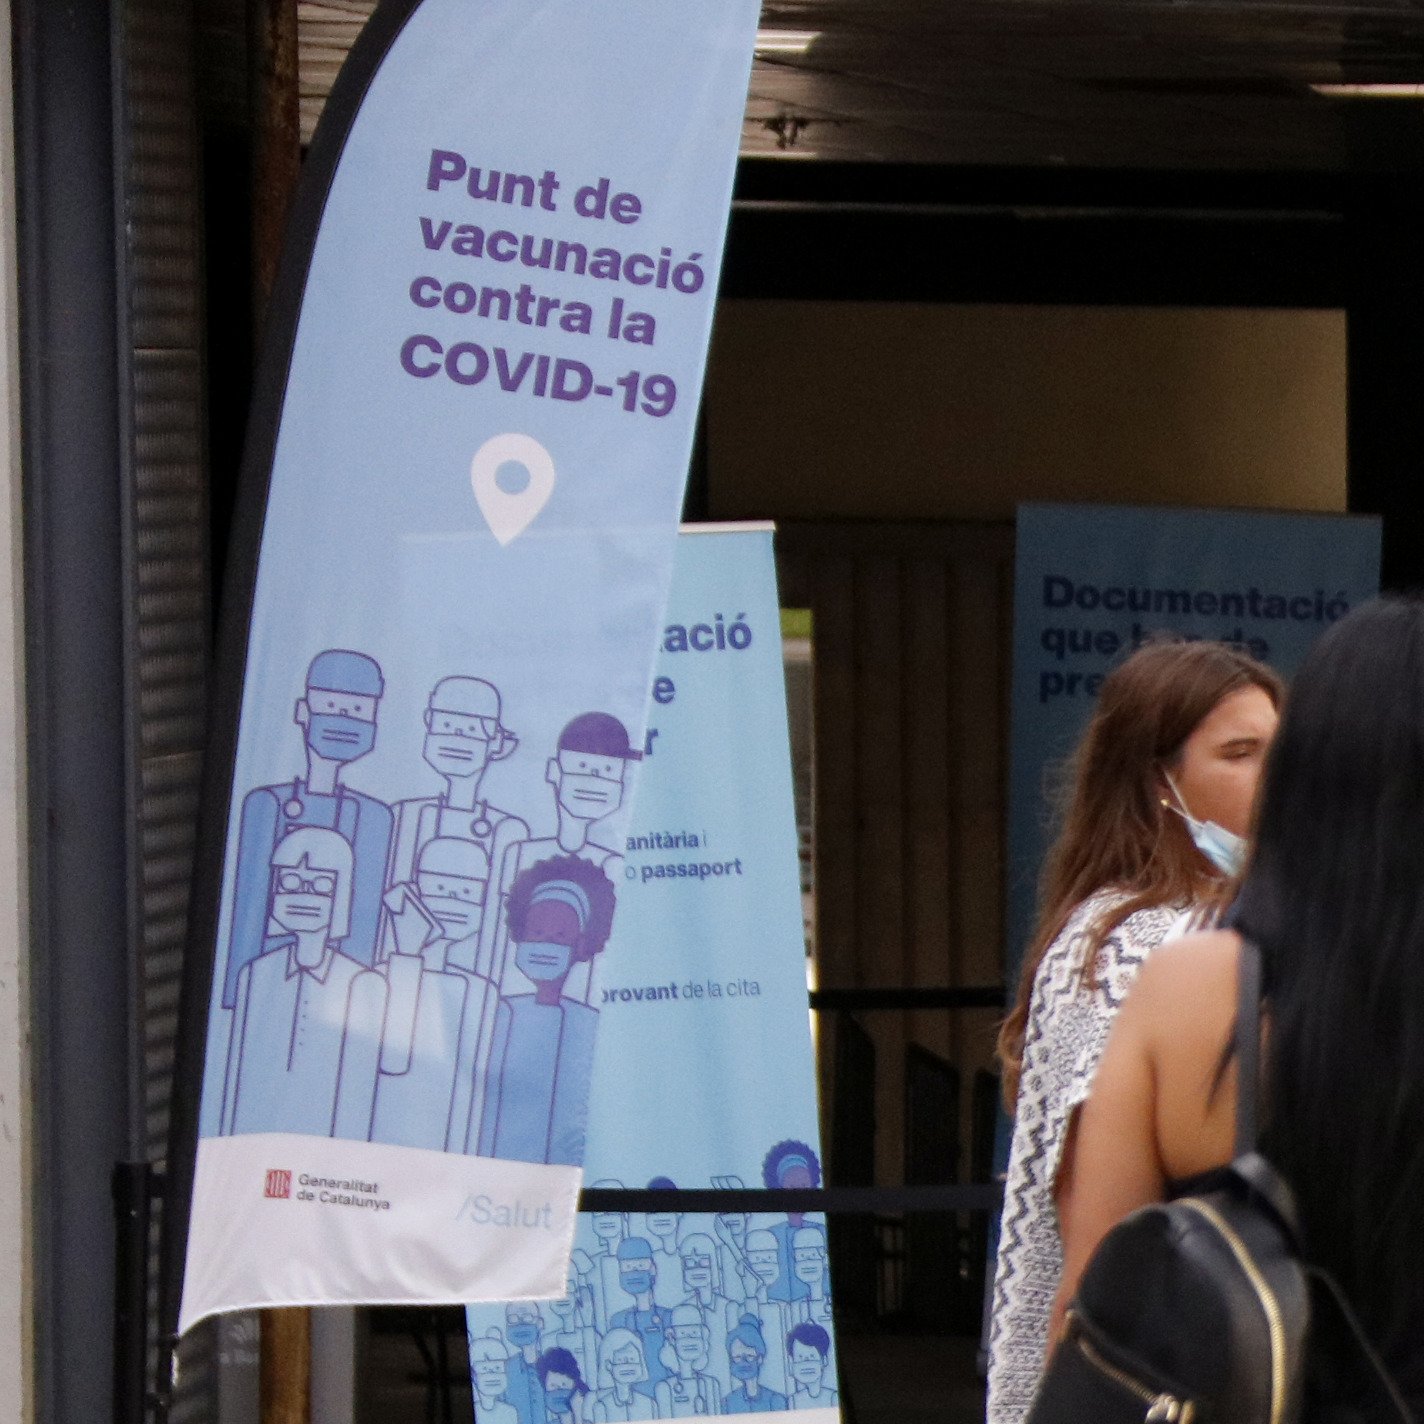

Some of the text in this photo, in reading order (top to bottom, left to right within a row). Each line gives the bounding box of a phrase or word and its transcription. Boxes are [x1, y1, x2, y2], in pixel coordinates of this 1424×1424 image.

[426, 149, 643, 225] Punt de
[418, 217, 705, 294] vacunació
[409, 275, 657, 346] contra la
[399, 334, 678, 418] COVID-19
[1043, 576, 1349, 621] Documentació
[660, 612, 752, 653] ació
[1039, 624, 1118, 662] que
[626, 831, 698, 850] anitària
[642, 858, 742, 883] passaport
[682, 979, 704, 1000] de
[706, 978, 722, 999] la
[725, 977, 761, 997] cita
[296, 1188, 390, 1212] de Catalunya
[297, 1172, 380, 1195] Generalitat
